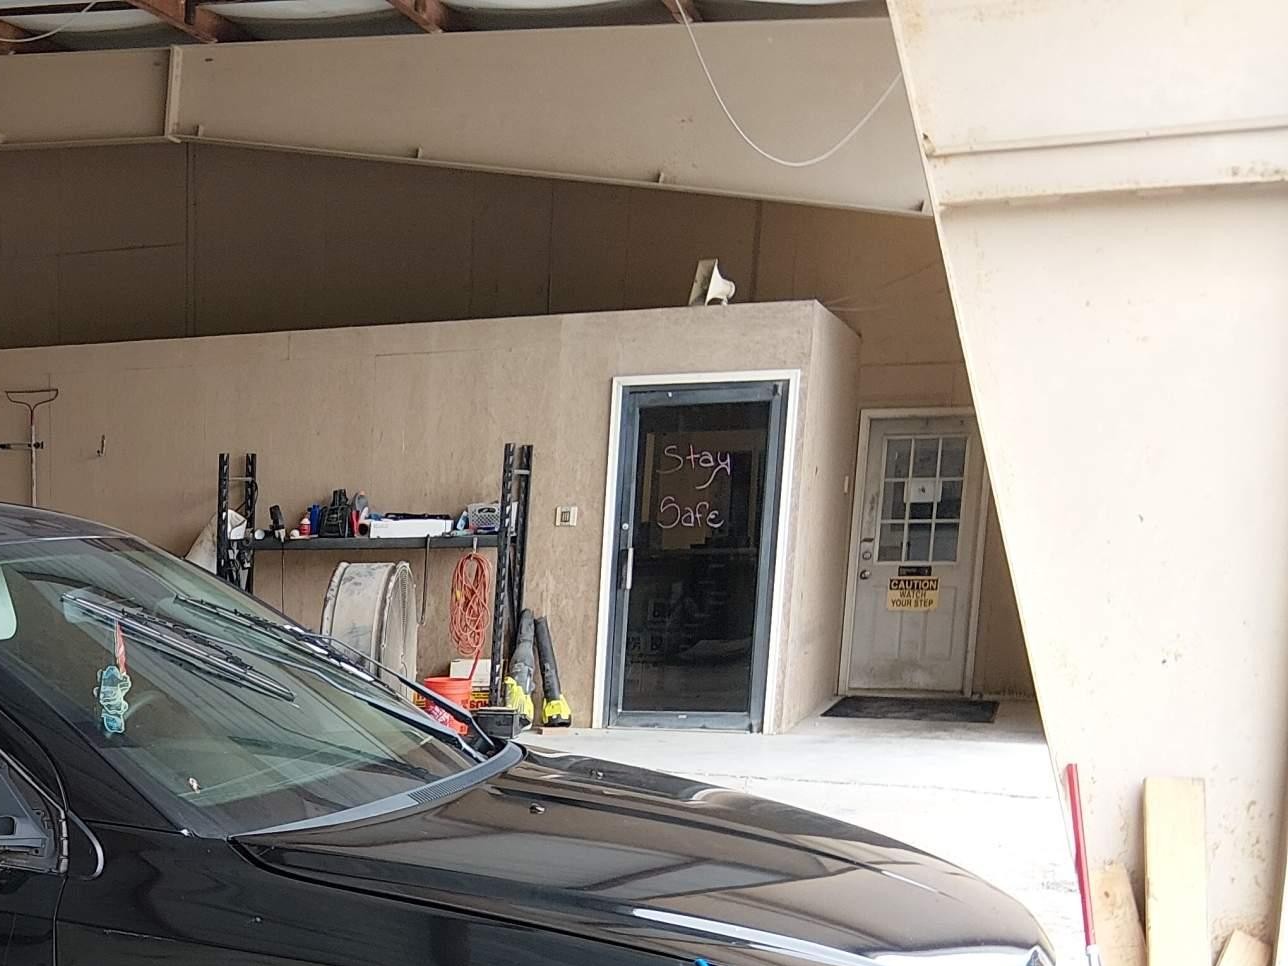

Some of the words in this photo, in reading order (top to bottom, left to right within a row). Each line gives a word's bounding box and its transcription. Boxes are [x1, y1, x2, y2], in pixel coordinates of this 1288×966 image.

[656, 444, 731, 490] Stay
[657, 496, 725, 529] Safe
[891, 580, 937, 590] CAUTION
[899, 590, 927, 599] WATCH
[891, 599, 912, 608] YOUR
[913, 599, 934, 608] STEP
